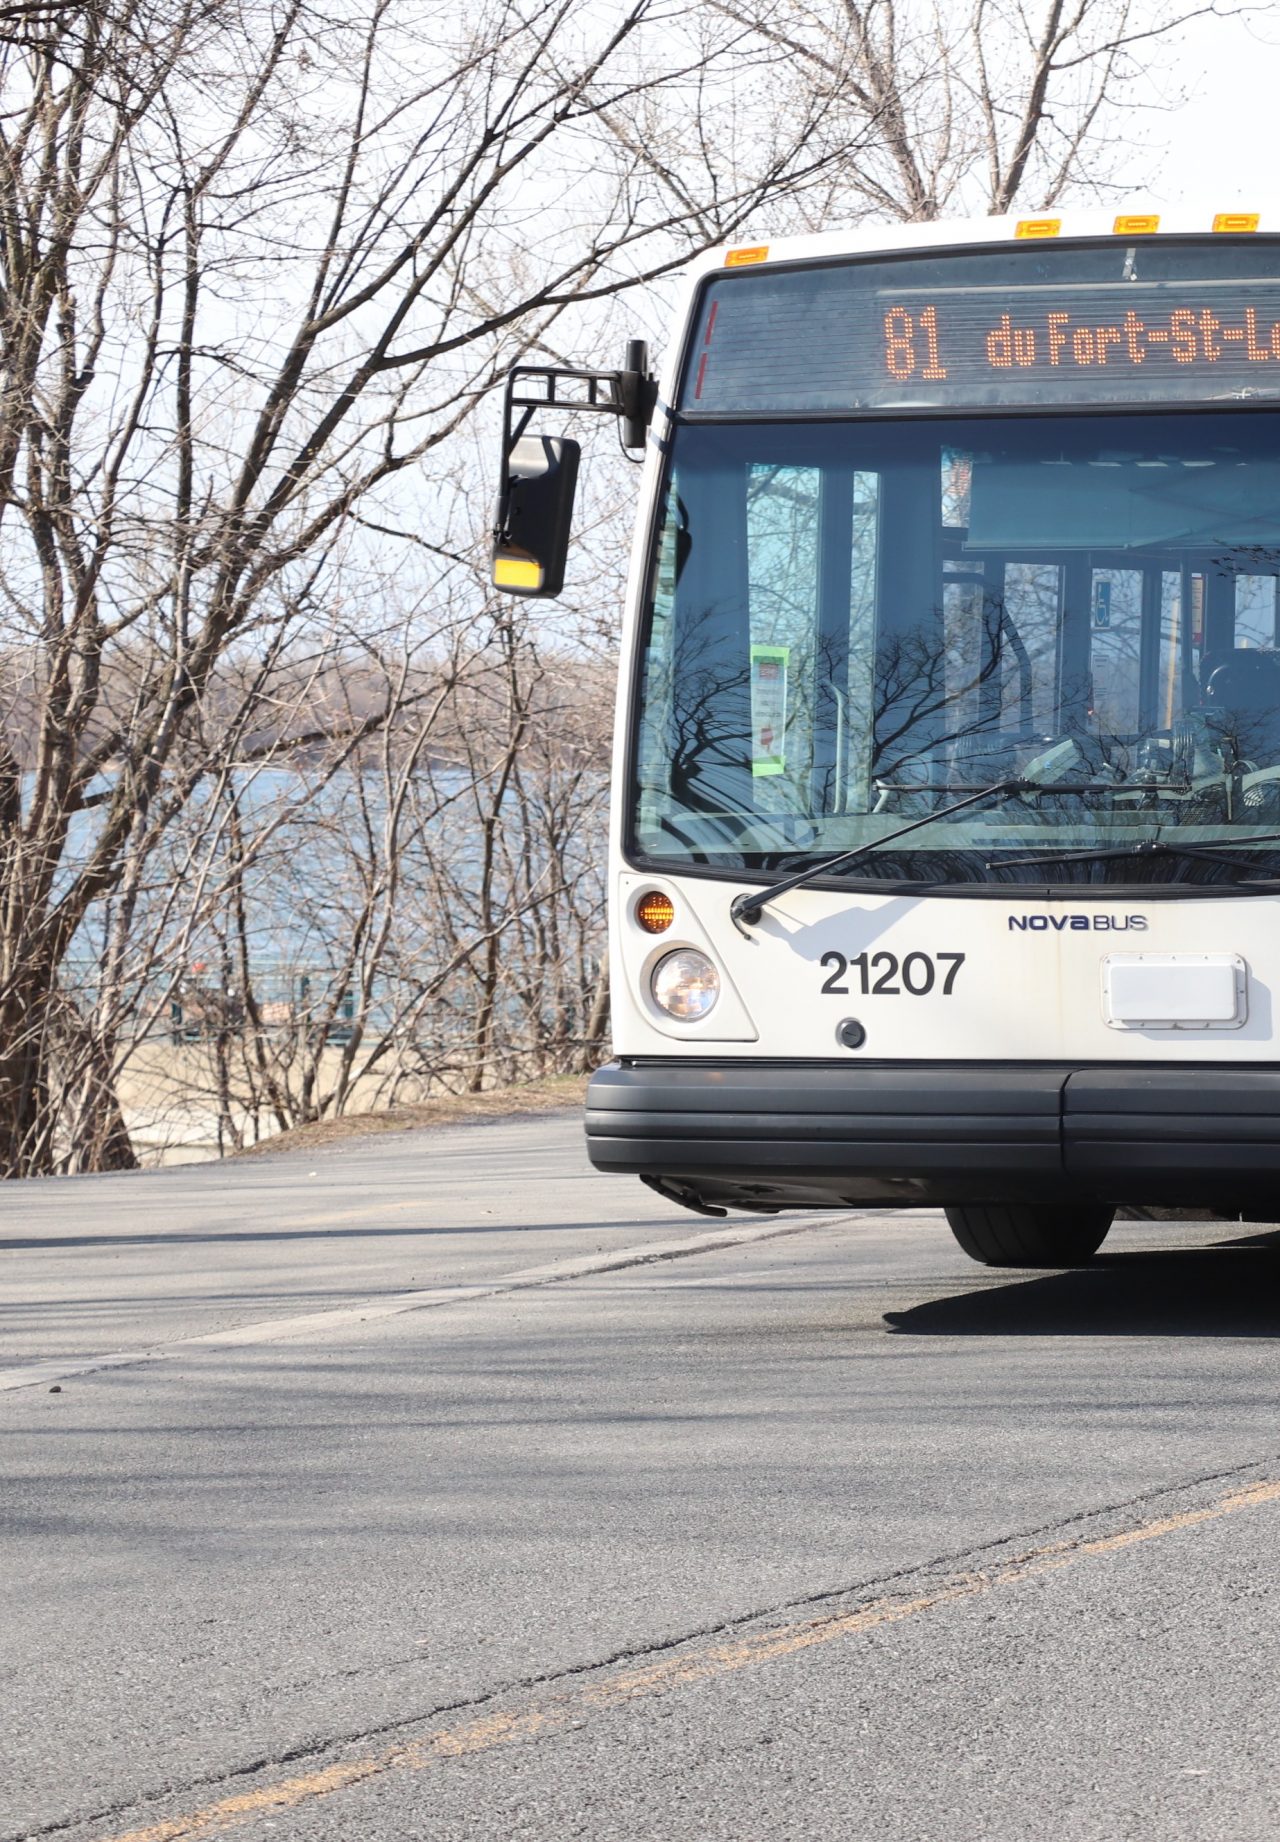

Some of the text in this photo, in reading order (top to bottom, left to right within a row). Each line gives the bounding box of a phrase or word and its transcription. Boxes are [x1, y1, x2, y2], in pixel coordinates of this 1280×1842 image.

[881, 305, 946, 381] 81
[985, 315, 1036, 367] du
[819, 951, 966, 997] 21207
